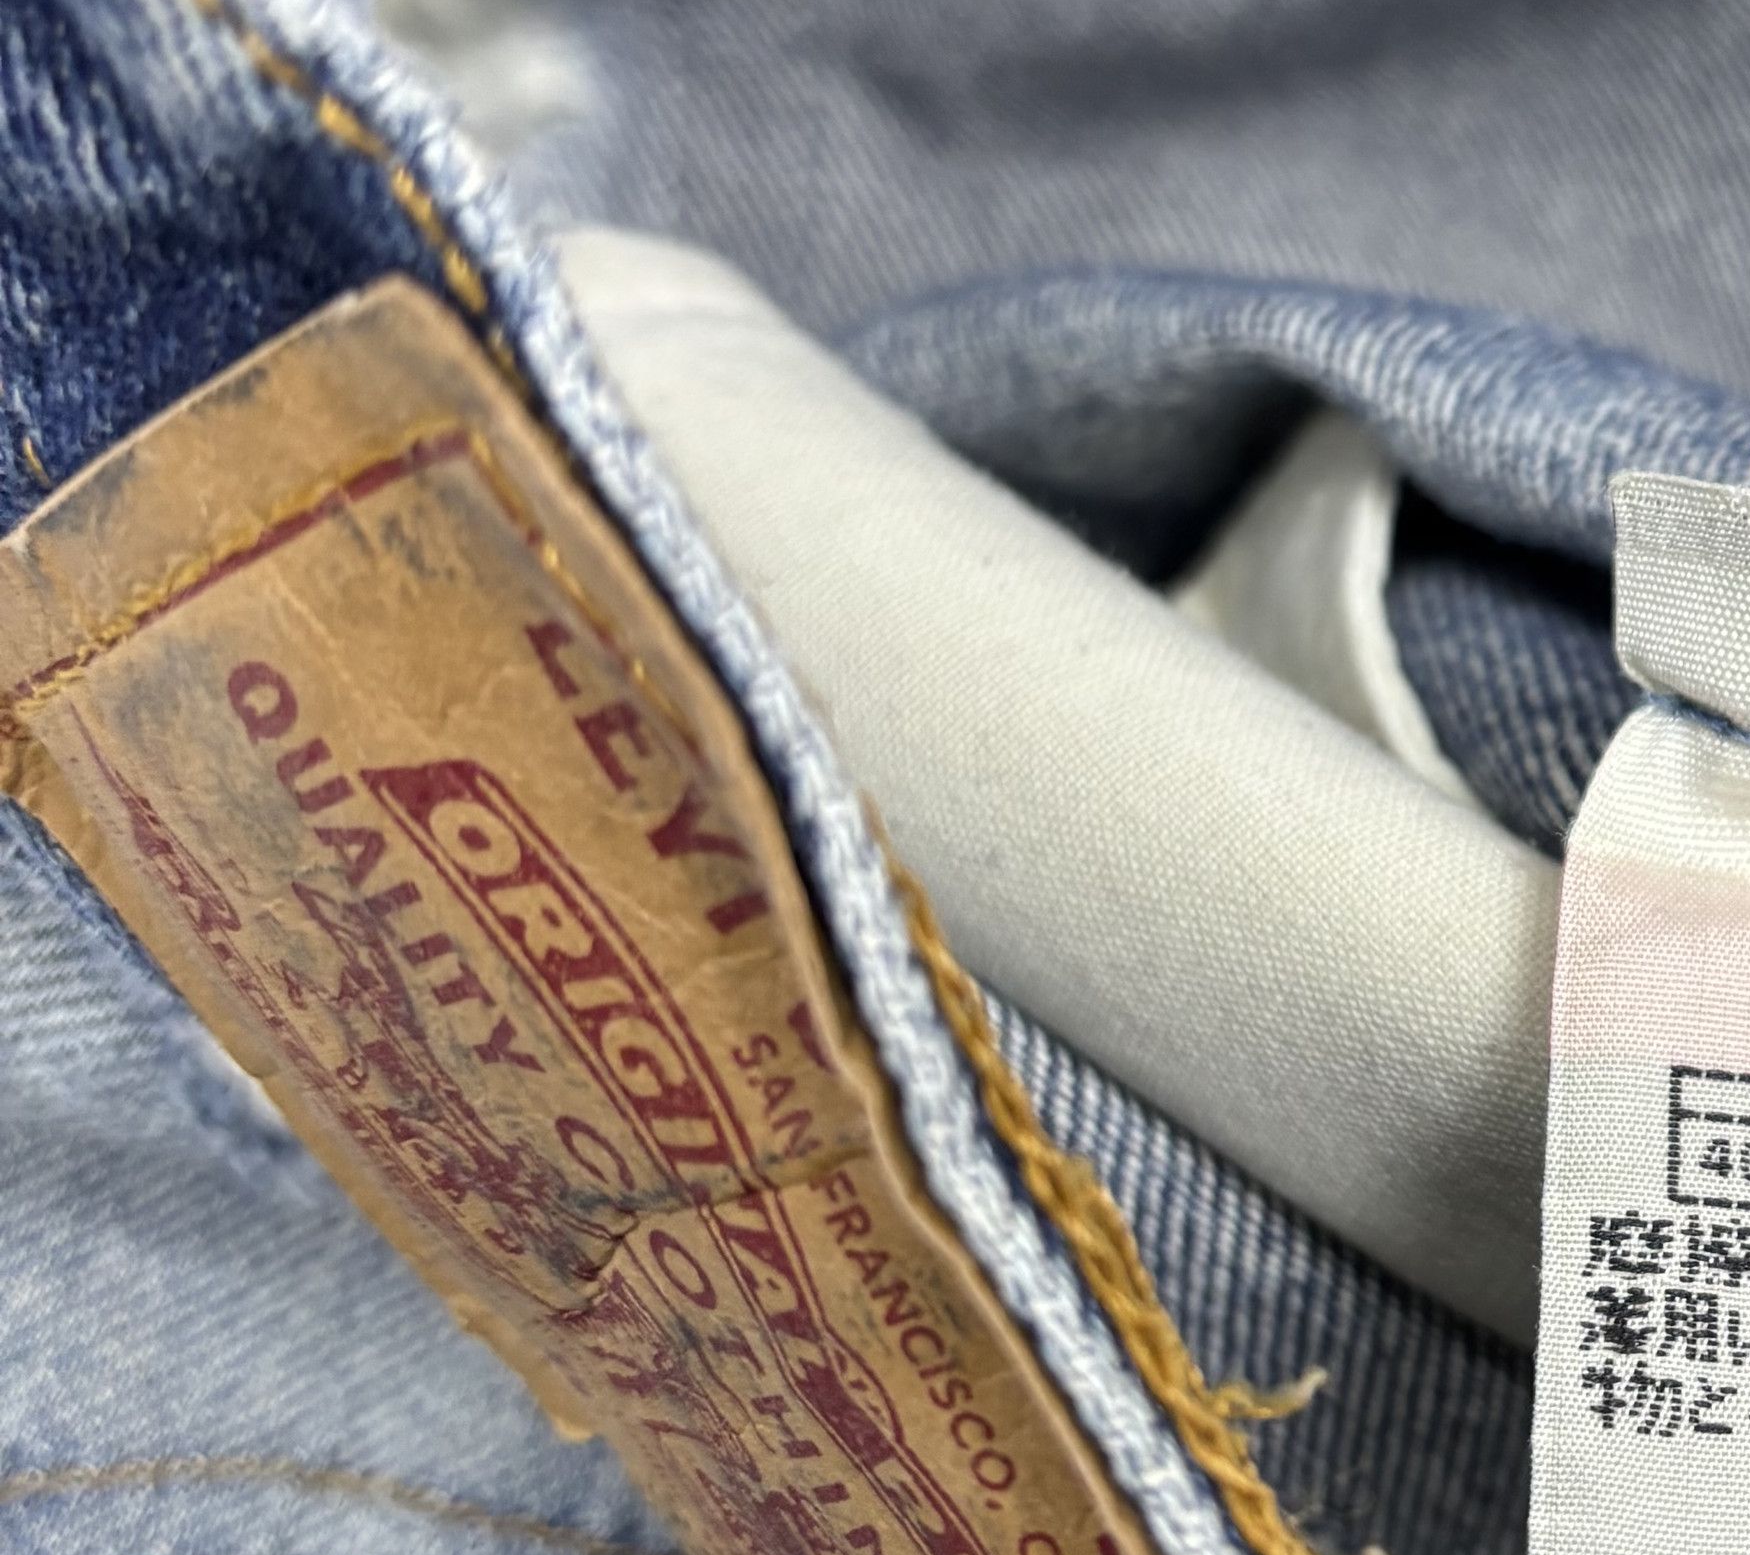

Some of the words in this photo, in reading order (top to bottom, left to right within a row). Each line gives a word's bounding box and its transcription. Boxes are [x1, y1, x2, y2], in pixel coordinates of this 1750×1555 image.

[227, 660, 547, 1074] QUALITY
[731, 1032, 822, 1160] SAN
[808, 1167, 1016, 1511] FRANCISCO,
